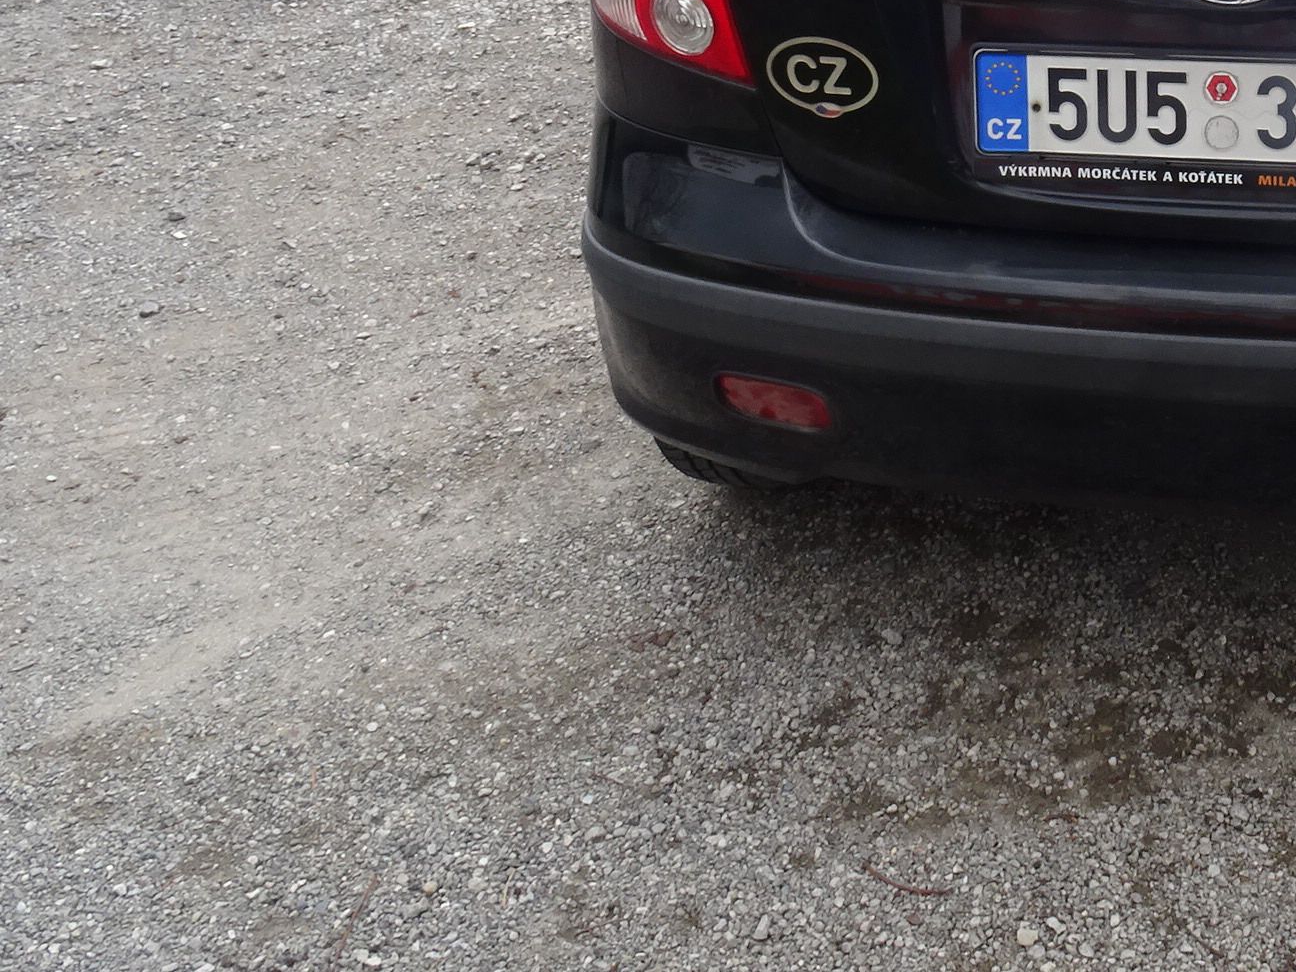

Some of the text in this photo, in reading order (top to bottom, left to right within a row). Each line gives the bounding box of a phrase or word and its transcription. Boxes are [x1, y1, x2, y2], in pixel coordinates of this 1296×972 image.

[786, 54, 852, 95] CZ
[1047, 67, 1188, 146] 5U5
[987, 117, 1022, 140] CZ
[998, 164, 1072, 178] VÝKRMNA
[1077, 165, 1158, 182] MORČÁTEK
[1163, 172, 1173, 182] A
[1178, 169, 1244, 185] KOŤÁTEK
